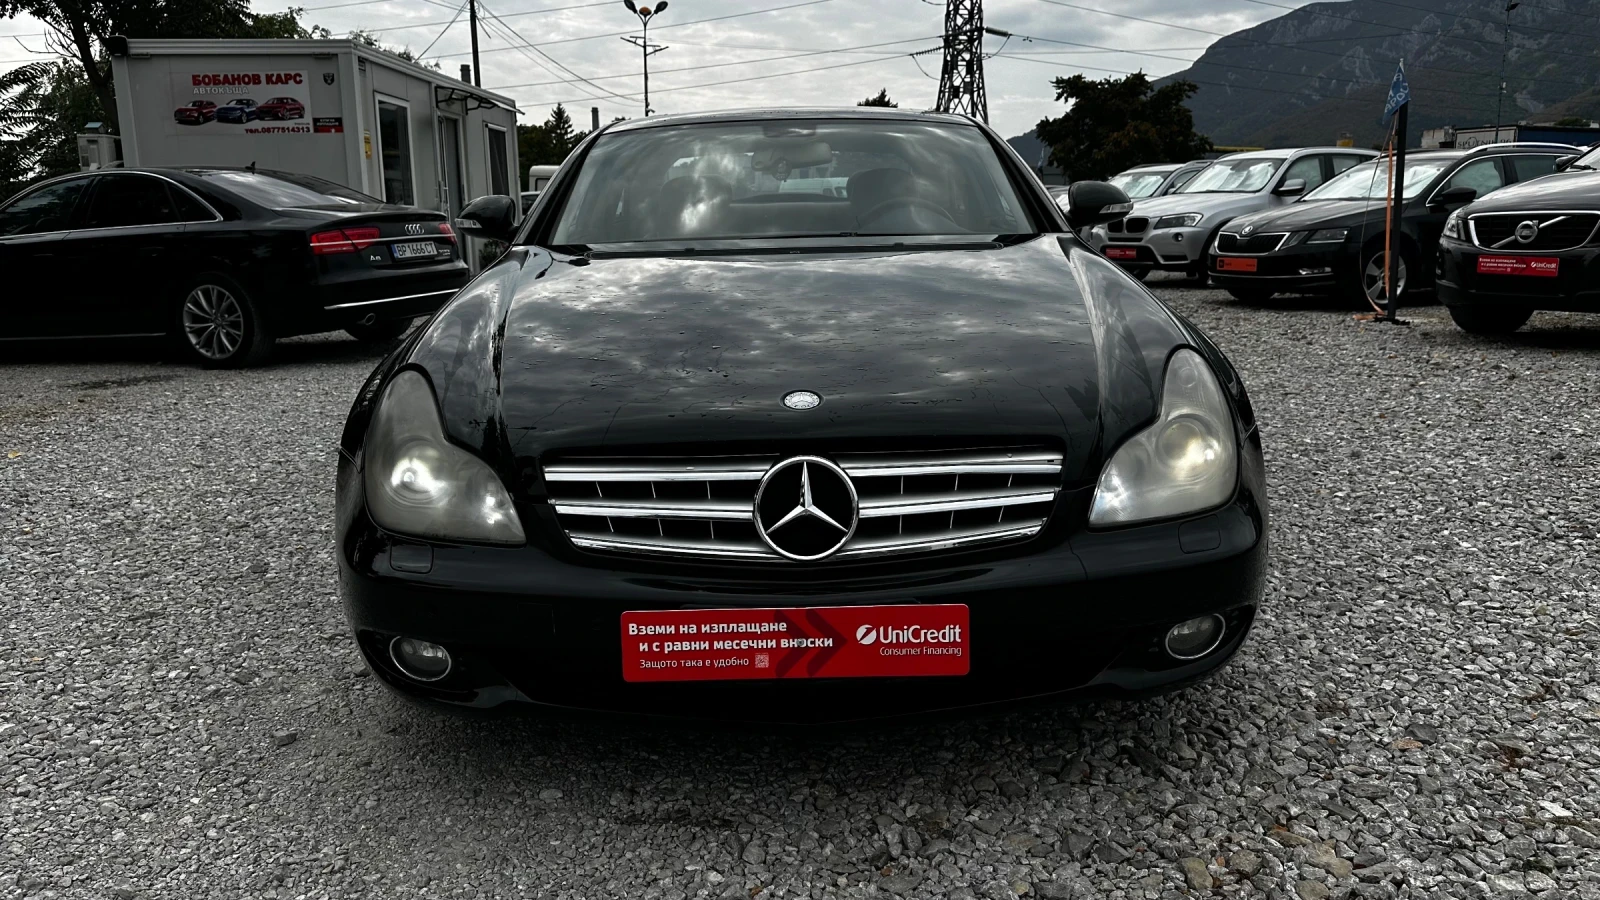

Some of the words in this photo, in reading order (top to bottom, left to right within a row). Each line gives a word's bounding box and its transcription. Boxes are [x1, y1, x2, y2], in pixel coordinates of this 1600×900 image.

[191, 73, 262, 86] БОБАНОВ
[265, 73, 303, 85] КАРС
[193, 87, 250, 95] АВТОКЪЩА
[244, 126, 311, 134] тел.0877514313
[407, 243, 426, 255] 1666
[628, 623, 675, 635] Вземи
[680, 624, 697, 634] на
[701, 622, 787, 634] изплащане
[880, 624, 962, 644] UniCredit
[639, 642, 649, 652] и
[652, 642, 660, 651] с
[664, 640, 709, 654] равни
[713, 638, 777, 650] месечни
[780, 637, 833, 648] вноски
[879, 646, 921, 656] Consumer
[923, 646, 962, 657] Financing
[639, 659, 678, 669] Защото
[713, 657, 750, 668] удобно
